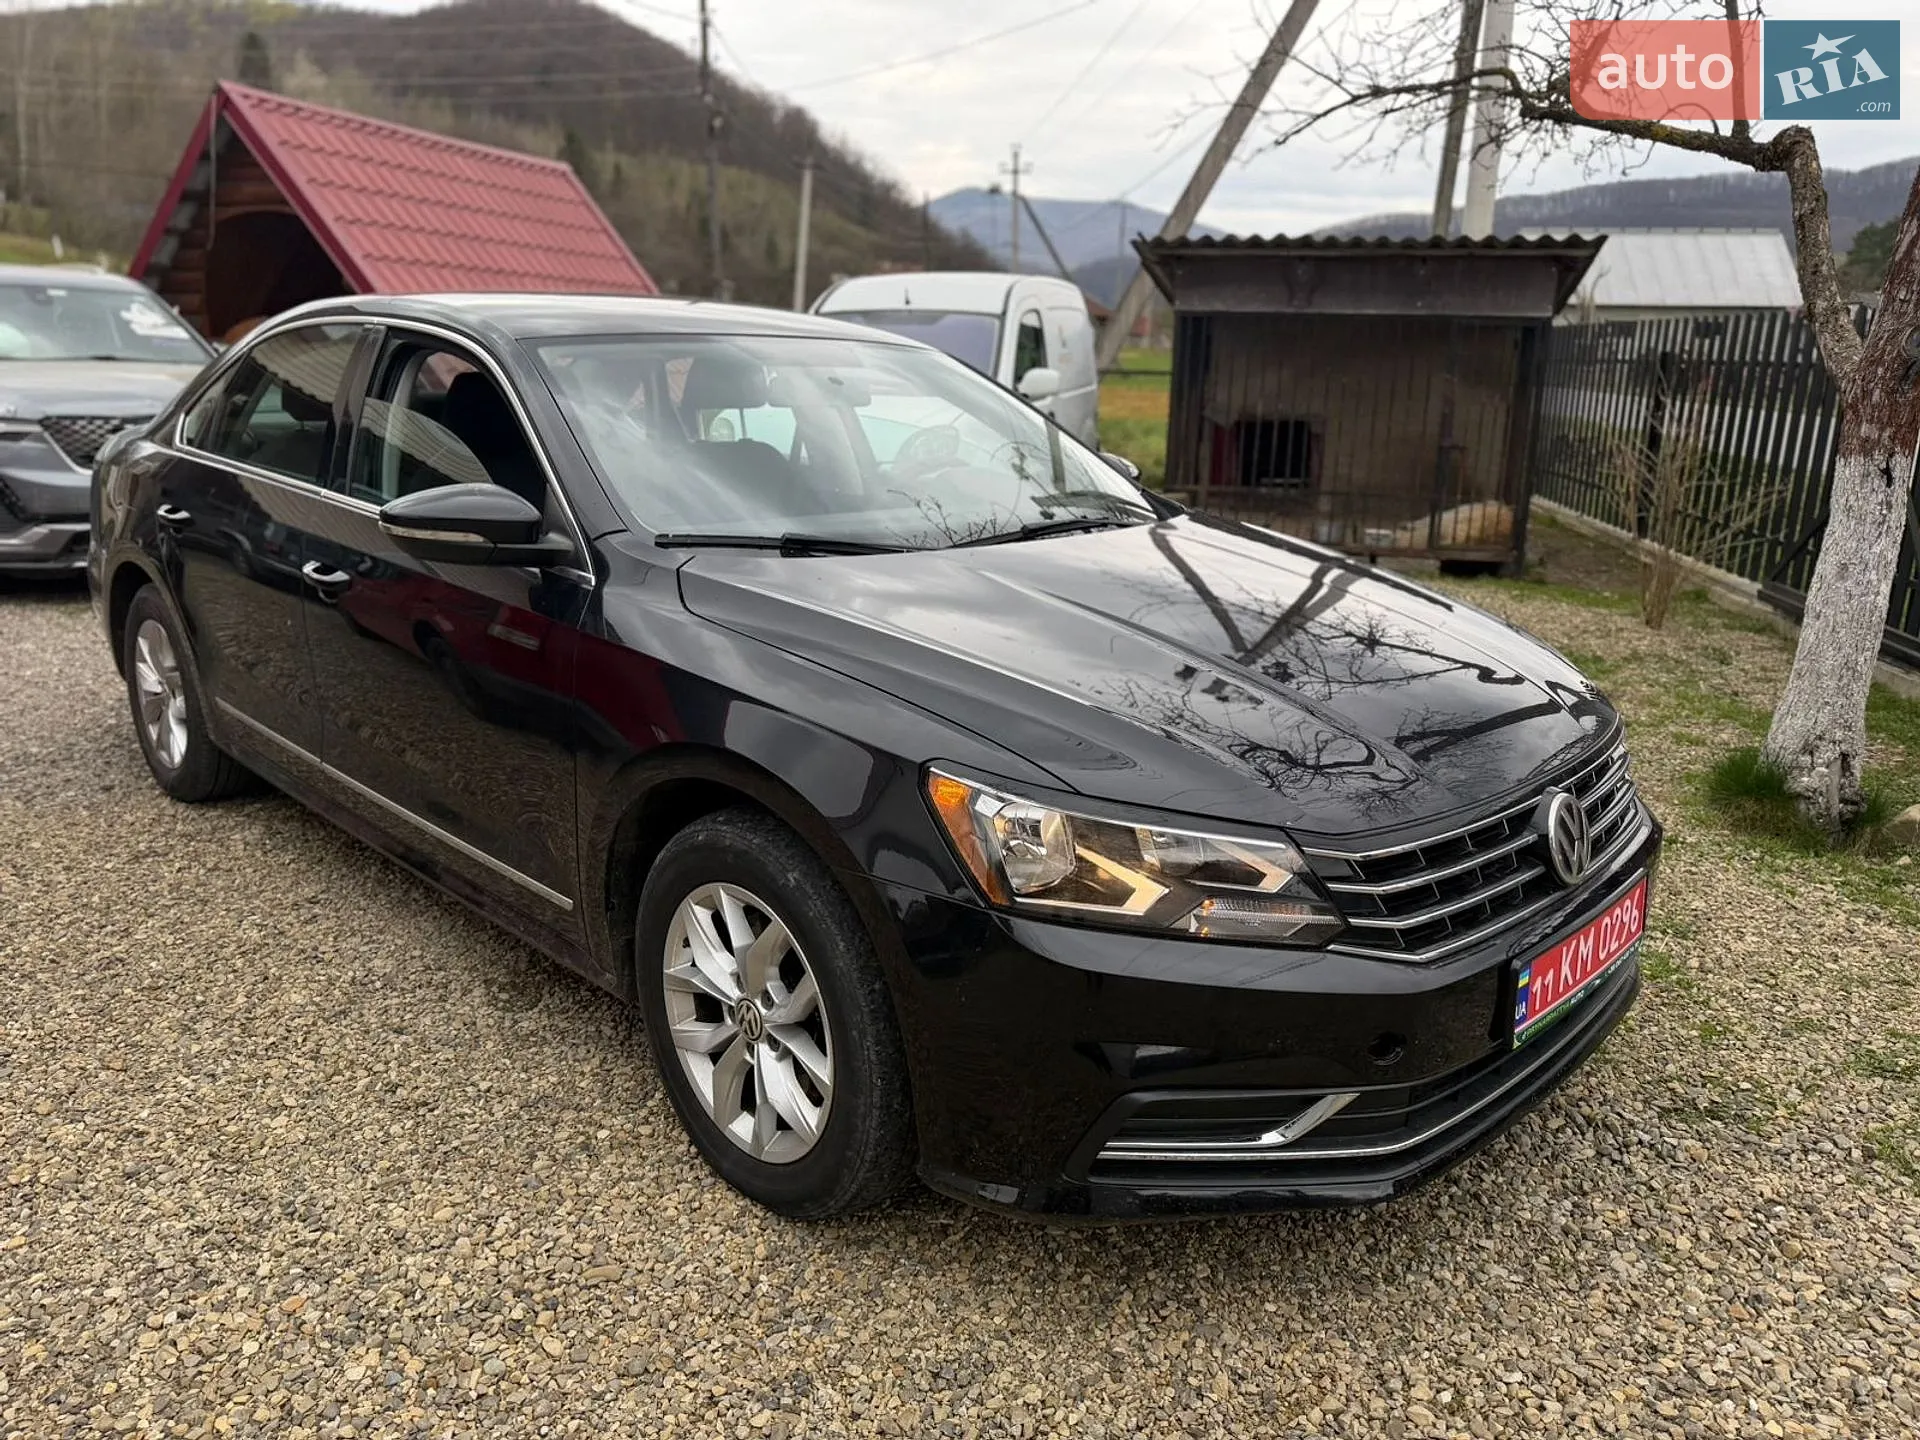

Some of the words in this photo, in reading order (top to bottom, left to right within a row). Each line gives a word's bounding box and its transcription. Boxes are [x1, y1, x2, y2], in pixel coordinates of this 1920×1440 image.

[1532, 975, 1554, 1011] 11
[1559, 926, 1596, 993] KM
[1598, 887, 1641, 961] 0296
[1515, 1001, 1527, 1020] UA
